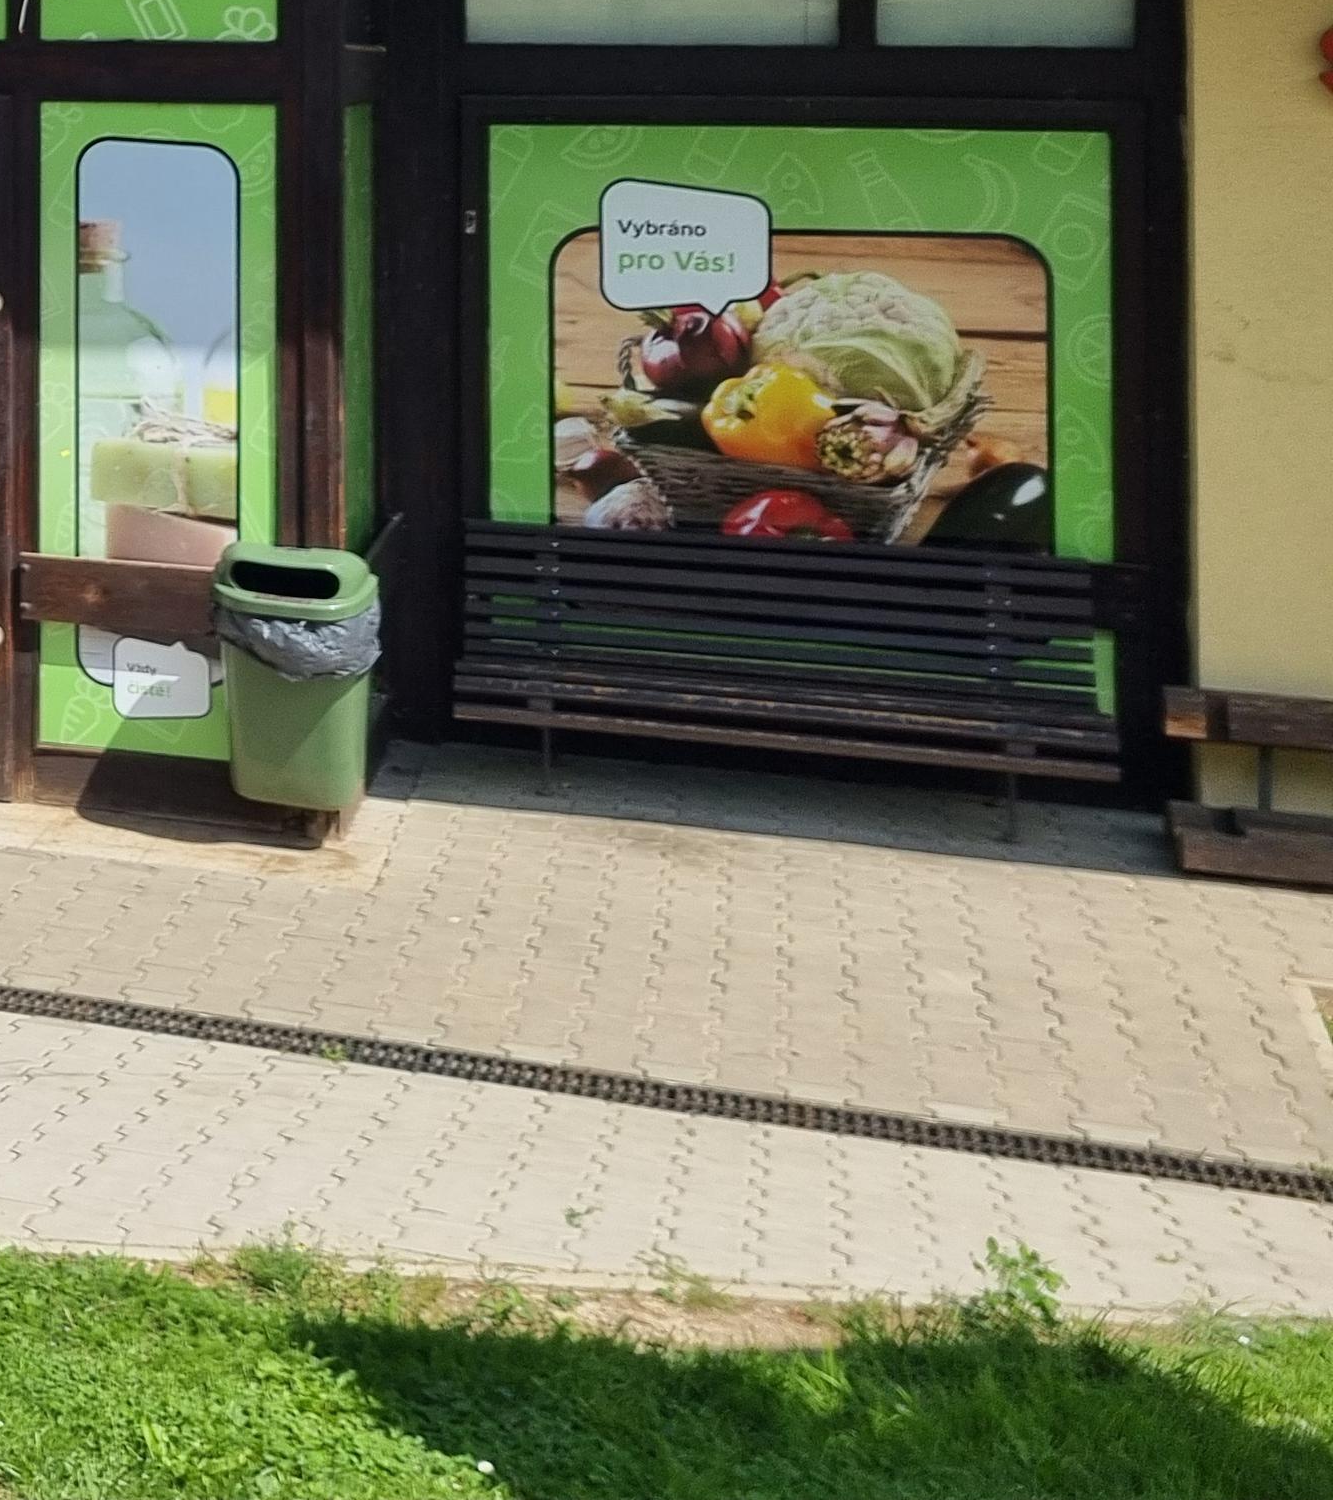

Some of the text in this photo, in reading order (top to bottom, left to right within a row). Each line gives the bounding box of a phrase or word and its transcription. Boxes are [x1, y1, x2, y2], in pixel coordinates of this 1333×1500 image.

[617, 219, 707, 238] Vybráno
[618, 250, 735, 274] pro Vás!
